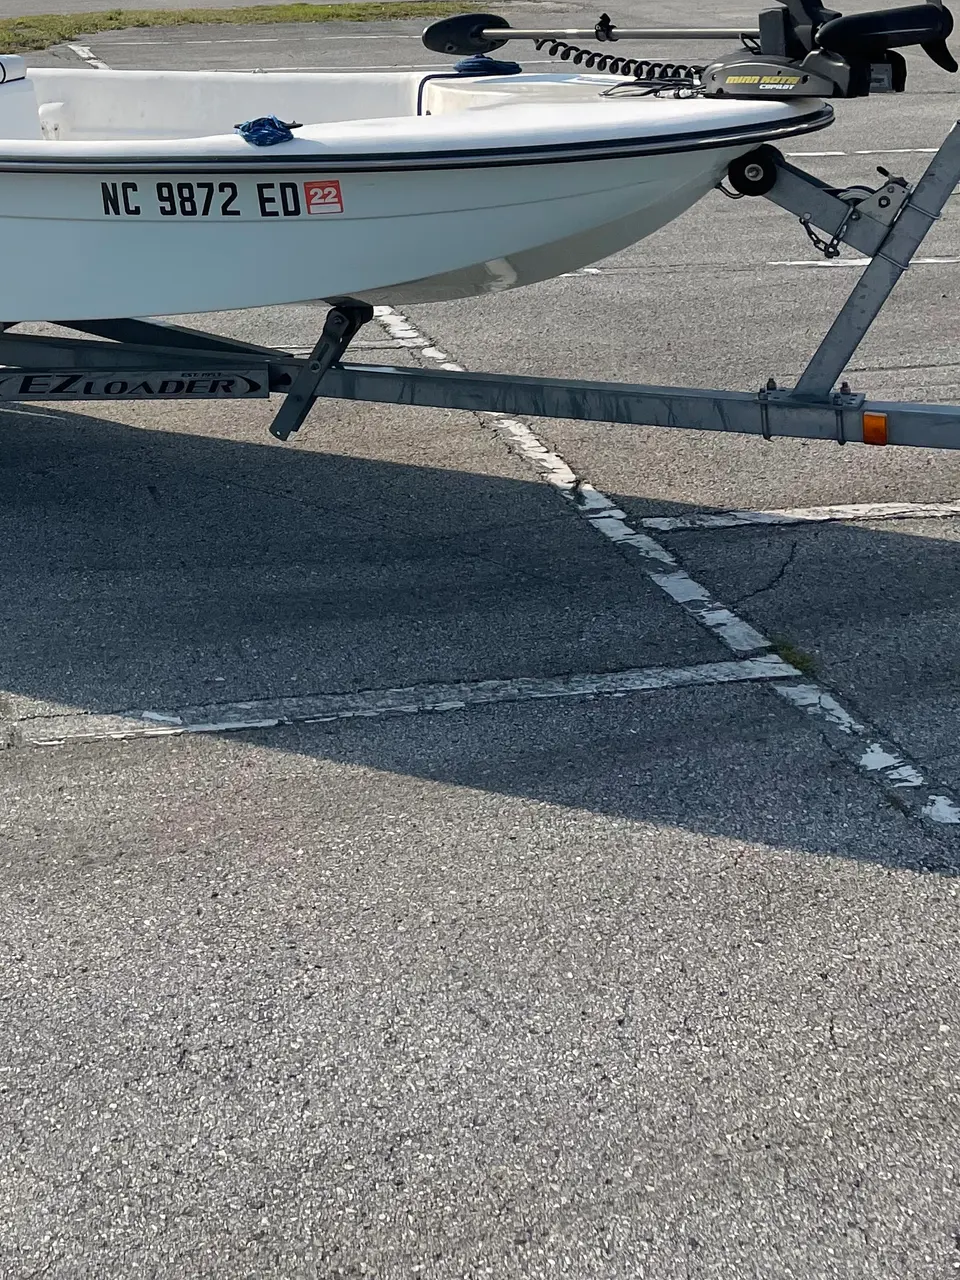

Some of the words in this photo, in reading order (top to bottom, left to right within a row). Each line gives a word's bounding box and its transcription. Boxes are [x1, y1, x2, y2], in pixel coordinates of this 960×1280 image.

[725, 75, 760, 84] MINN
[760, 75, 801, 85] KOTA
[101, 181, 141, 216] NC
[155, 181, 242, 216] 9872
[256, 181, 302, 217] ED
[309, 186, 339, 204] 22
